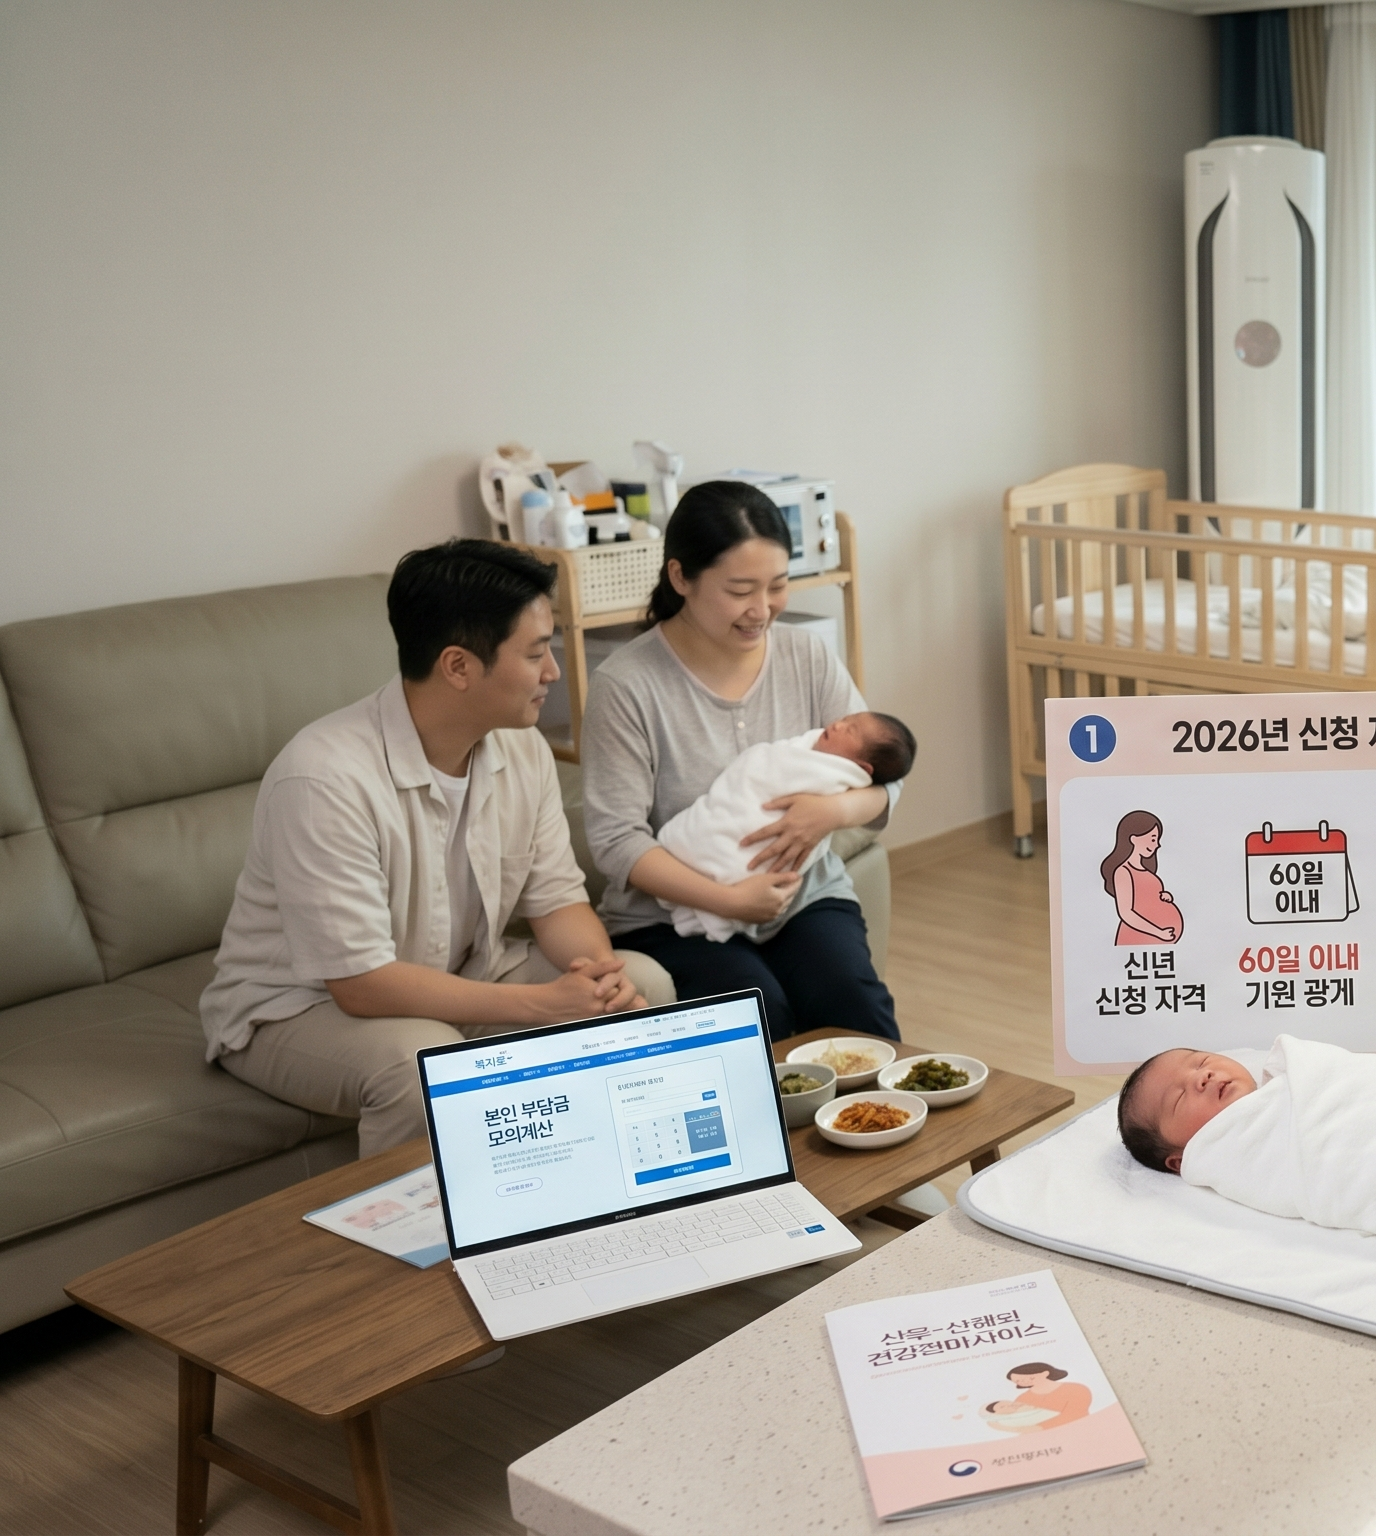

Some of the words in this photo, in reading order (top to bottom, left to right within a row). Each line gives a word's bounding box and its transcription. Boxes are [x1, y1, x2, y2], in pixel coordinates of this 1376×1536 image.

[1085, 724, 1098, 754] 1
[1171, 717, 1289, 753] 2026년
[1298, 715, 1359, 752] 신청
[1269, 860, 1324, 886] 60일
[1275, 888, 1320, 914] 이내
[1123, 950, 1176, 981] 신년
[1238, 944, 1300, 974] 60일
[1308, 942, 1359, 971] 이내
[1095, 984, 1147, 1016] 신청
[1154, 983, 1206, 1014] 자격
[1245, 979, 1296, 1010] 기원
[484, 1104, 518, 1127] 본인
[521, 1095, 570, 1119] 부담금
[488, 1119, 554, 1148] 모의계산
